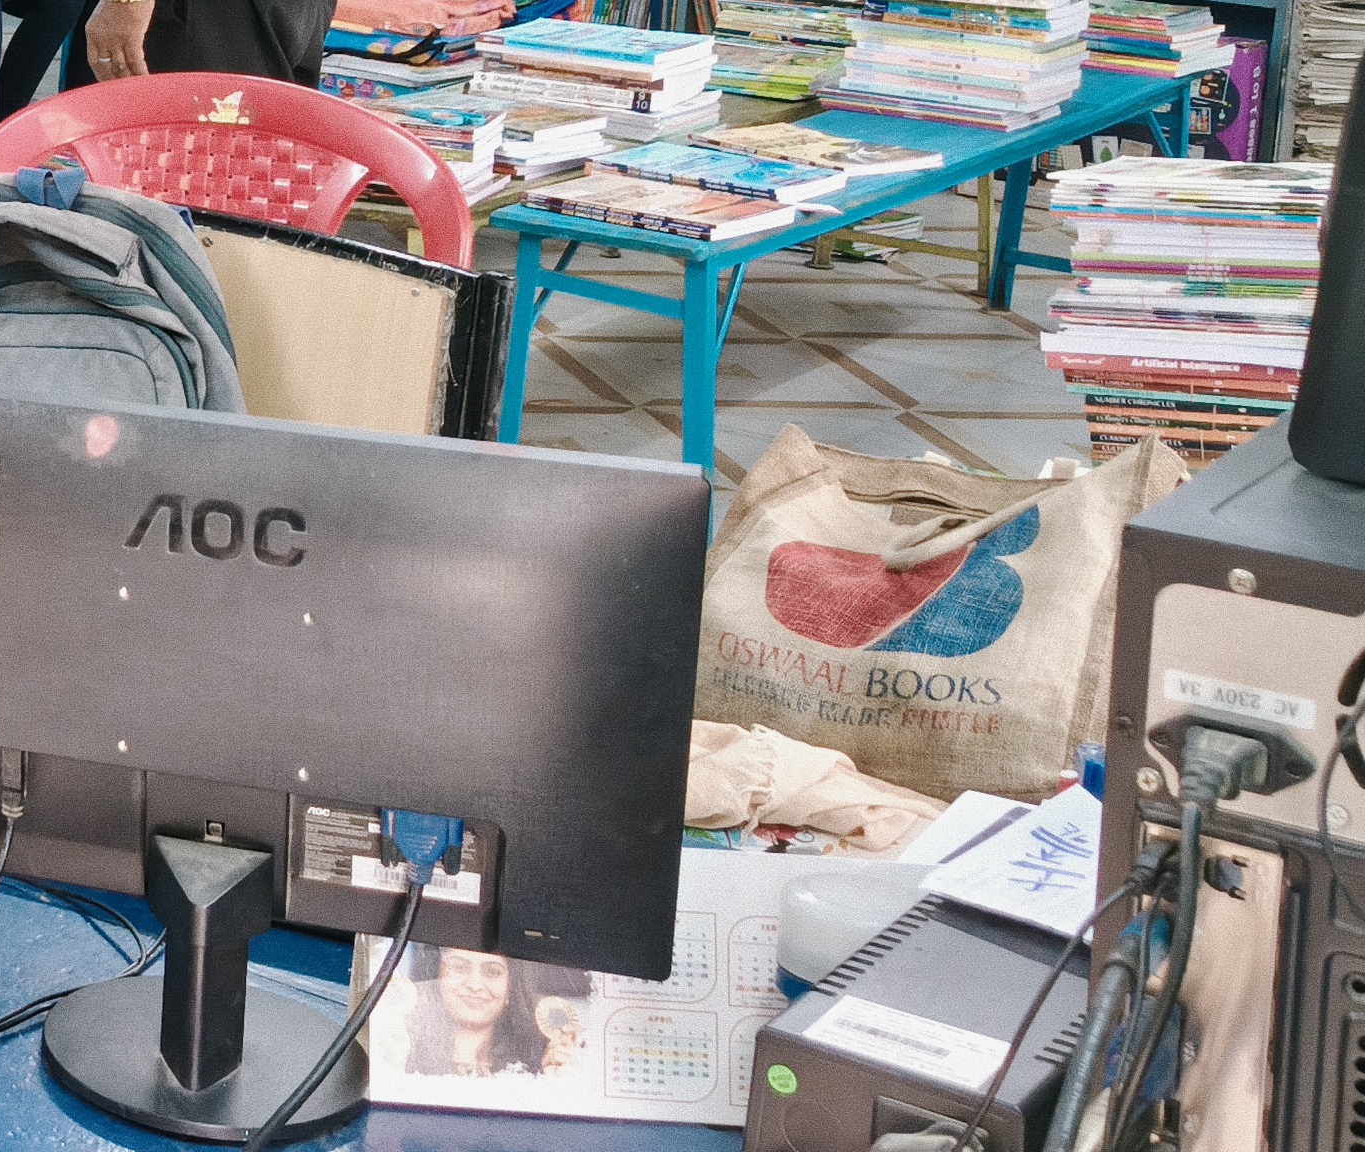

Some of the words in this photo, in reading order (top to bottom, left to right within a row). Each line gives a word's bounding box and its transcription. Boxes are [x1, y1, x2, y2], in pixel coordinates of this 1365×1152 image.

[635, 100, 648, 110] 10
[1131, 358, 1178, 369] Artificial
[125, 493, 308, 568] AOC
[718, 630, 852, 695] OSWAAL
[865, 666, 1004, 705] BOOKS
[1178, 677, 1204, 698] 3A
[1213, 688, 1264, 711] 230V
[1273, 699, 1300, 718] AC
[306, 806, 331, 818] AOC
